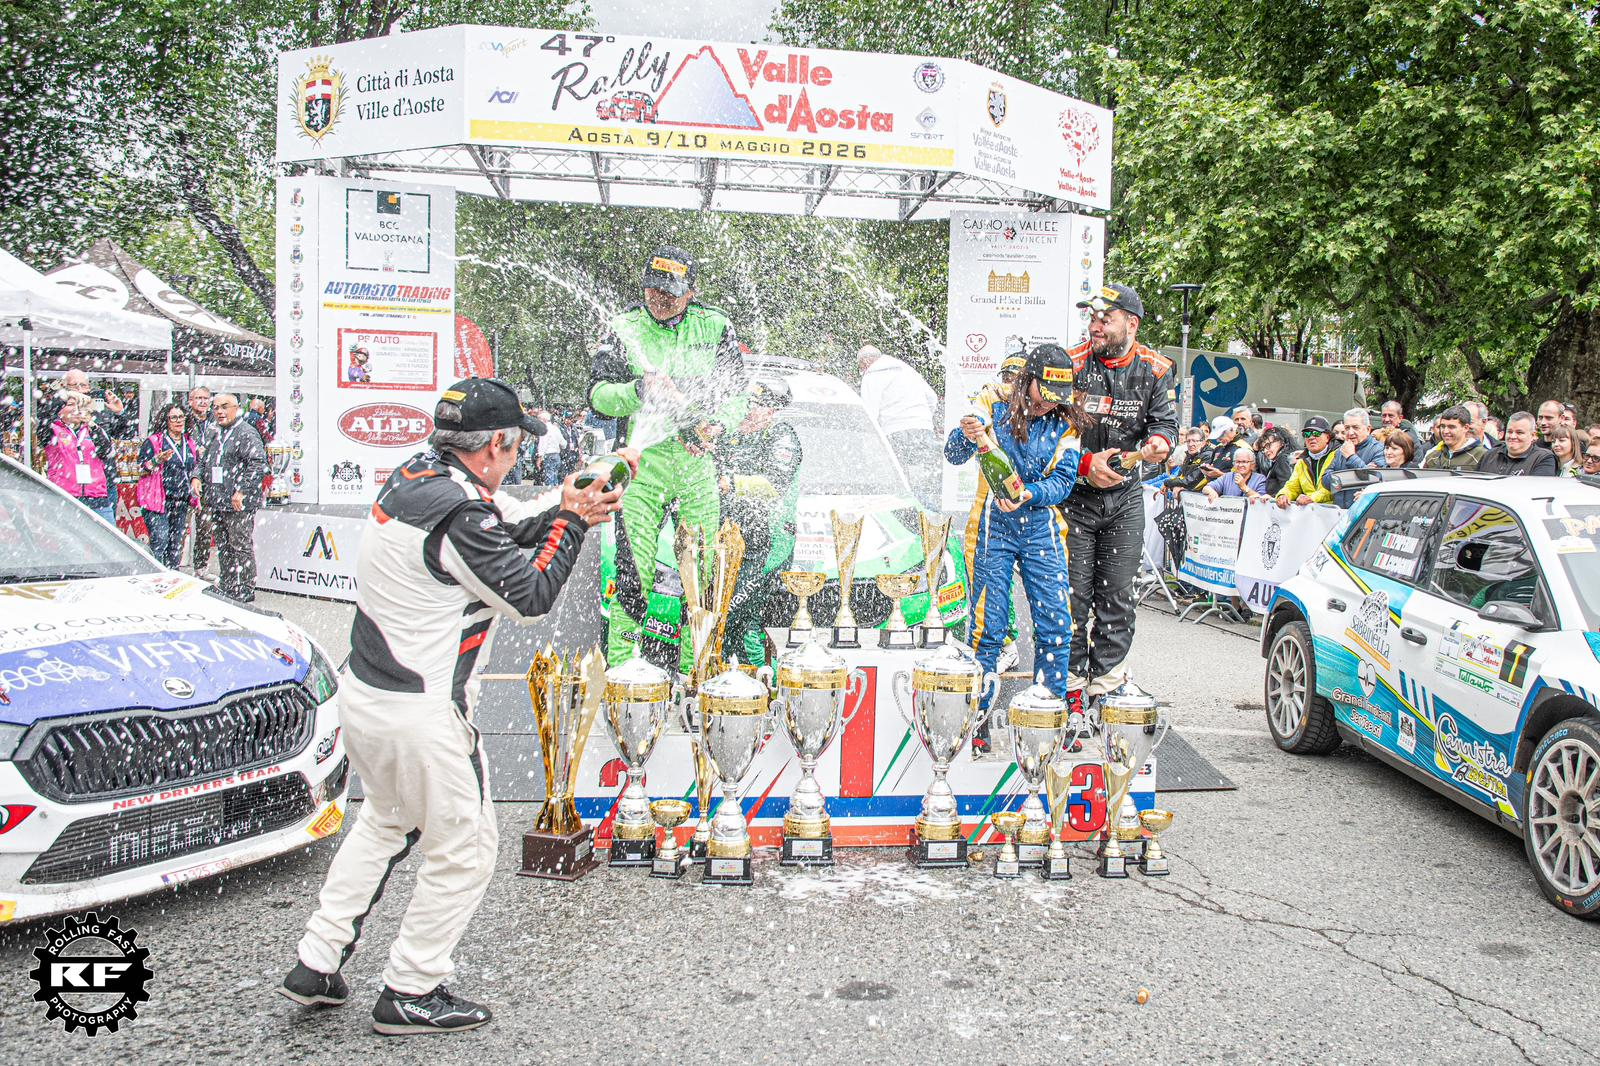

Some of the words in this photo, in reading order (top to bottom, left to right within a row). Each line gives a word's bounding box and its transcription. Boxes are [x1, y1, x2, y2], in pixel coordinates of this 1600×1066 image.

[550, 41, 671, 111] Rally
[737, 47, 833, 89] Valle
[356, 70, 391, 94] Città
[395, 70, 408, 88] di
[413, 66, 455, 87] Aosta
[356, 98, 389, 121] Ville
[393, 98, 445, 118] d'Aoste
[763, 86, 894, 134] d'Aosta
[568, 127, 635, 146] AOSTA
[646, 131, 708, 150] 9/10
[720, 139, 790, 155] MAGGIO
[801, 141, 867, 160] 2026
[379, 221, 400, 230] BCC
[354, 232, 425, 245] VALDOSTANA
[970, 295, 998, 305] Grand
[1024, 296, 1047, 305] Billia
[373, 335, 400, 345] AUTO
[348, 416, 427, 434] ALPE
[1100, 417, 1122, 428] Italy
[65, 612, 206, 629] CORDISCO
[89, 638, 273, 673] VIFRAM
[112, 794, 154, 811] NEW
[159, 777, 235, 800] DRIVER'S
[239, 764, 282, 783] TEAM
[1068, 763, 1107, 832] 3
[403, 1003, 432, 1018] sparco
